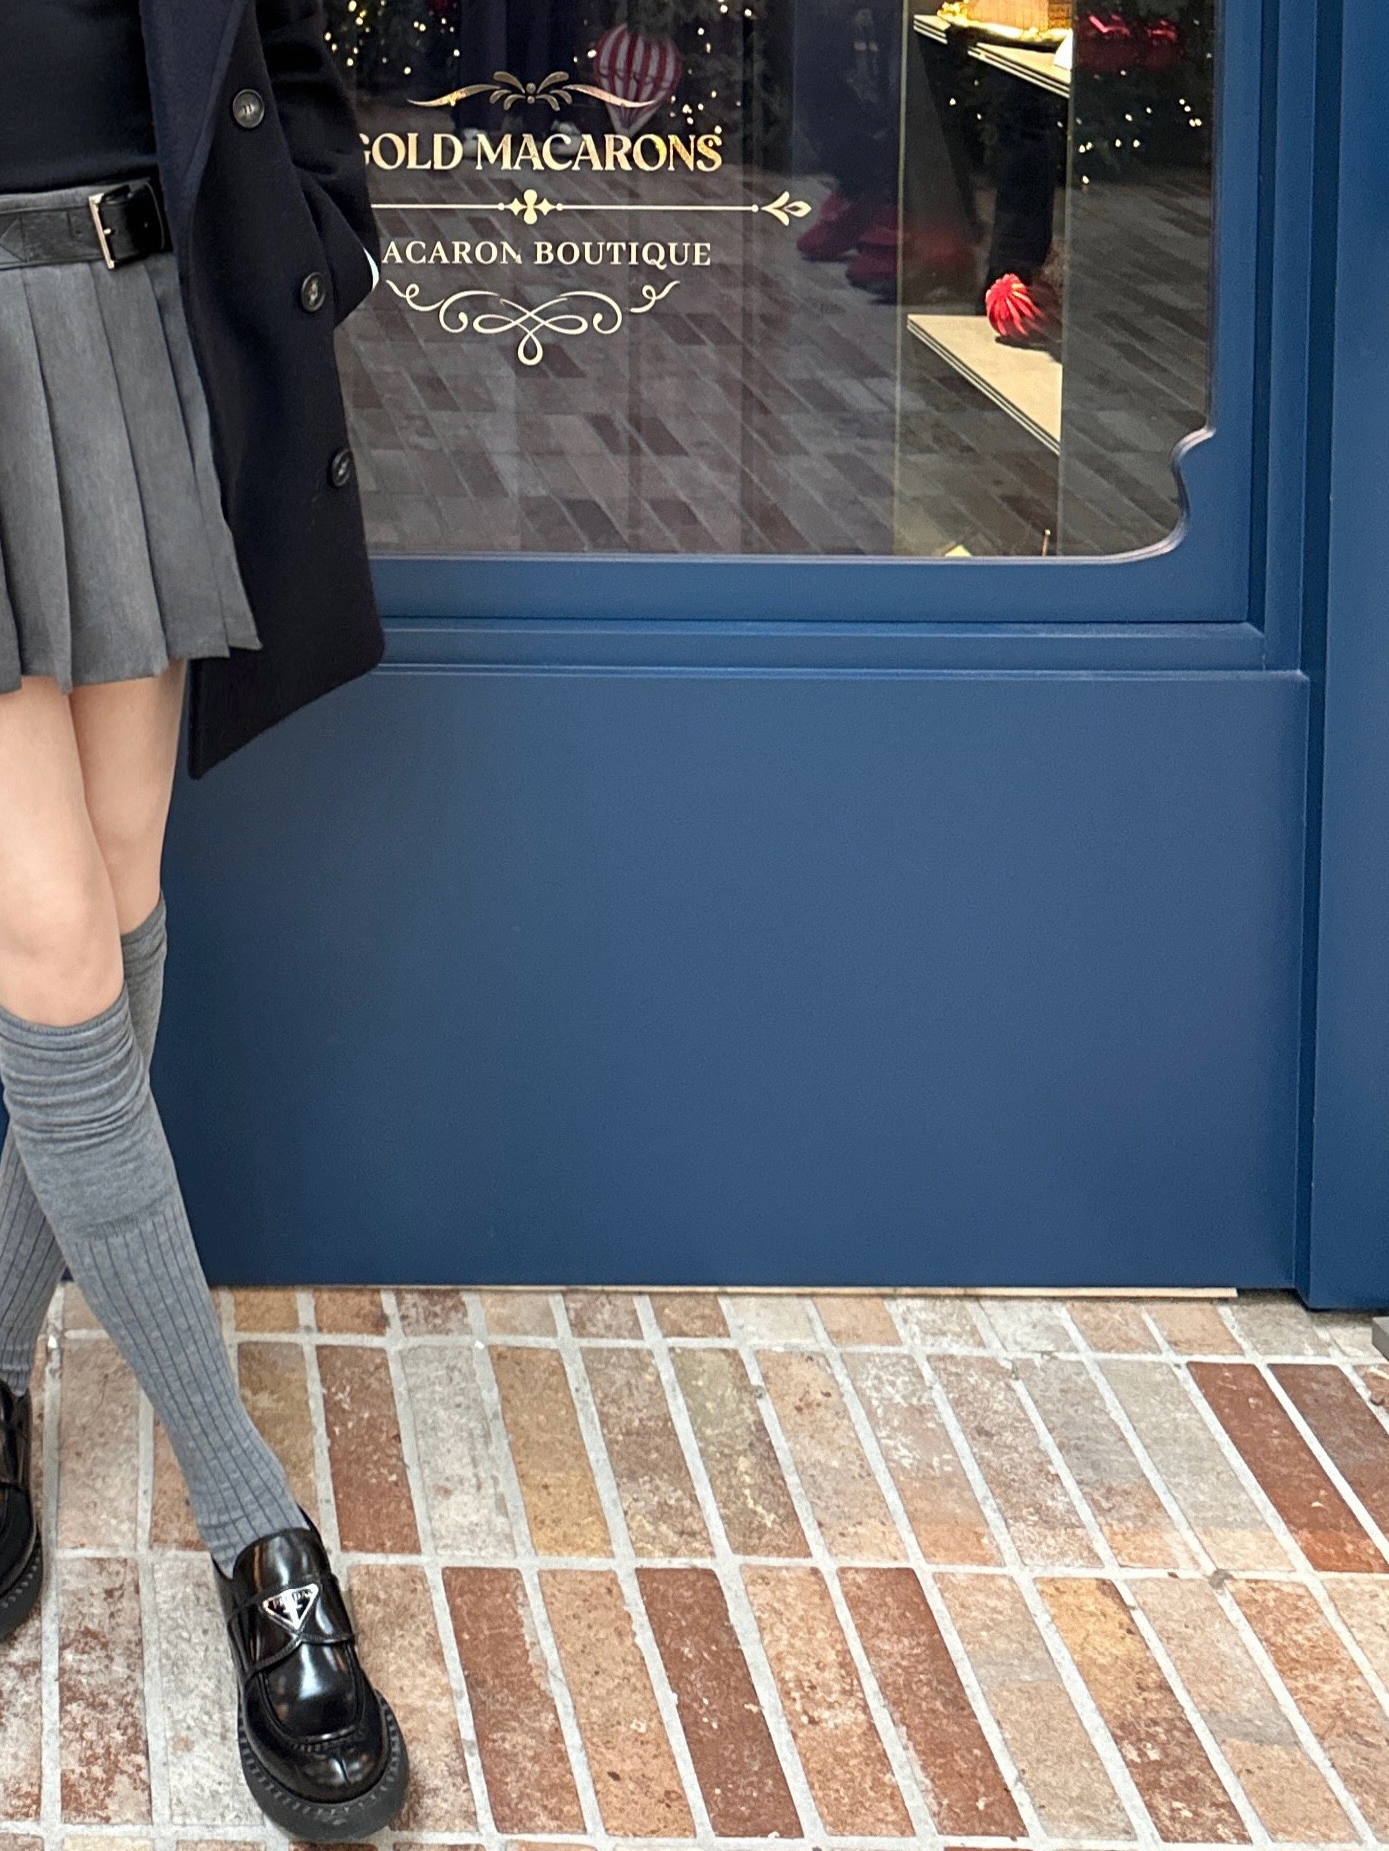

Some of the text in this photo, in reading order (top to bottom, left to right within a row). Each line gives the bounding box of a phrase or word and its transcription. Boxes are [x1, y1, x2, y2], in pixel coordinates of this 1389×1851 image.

[475, 133, 723, 172] MACARONS
[381, 240, 712, 270] ACARON BOUTIQUE
